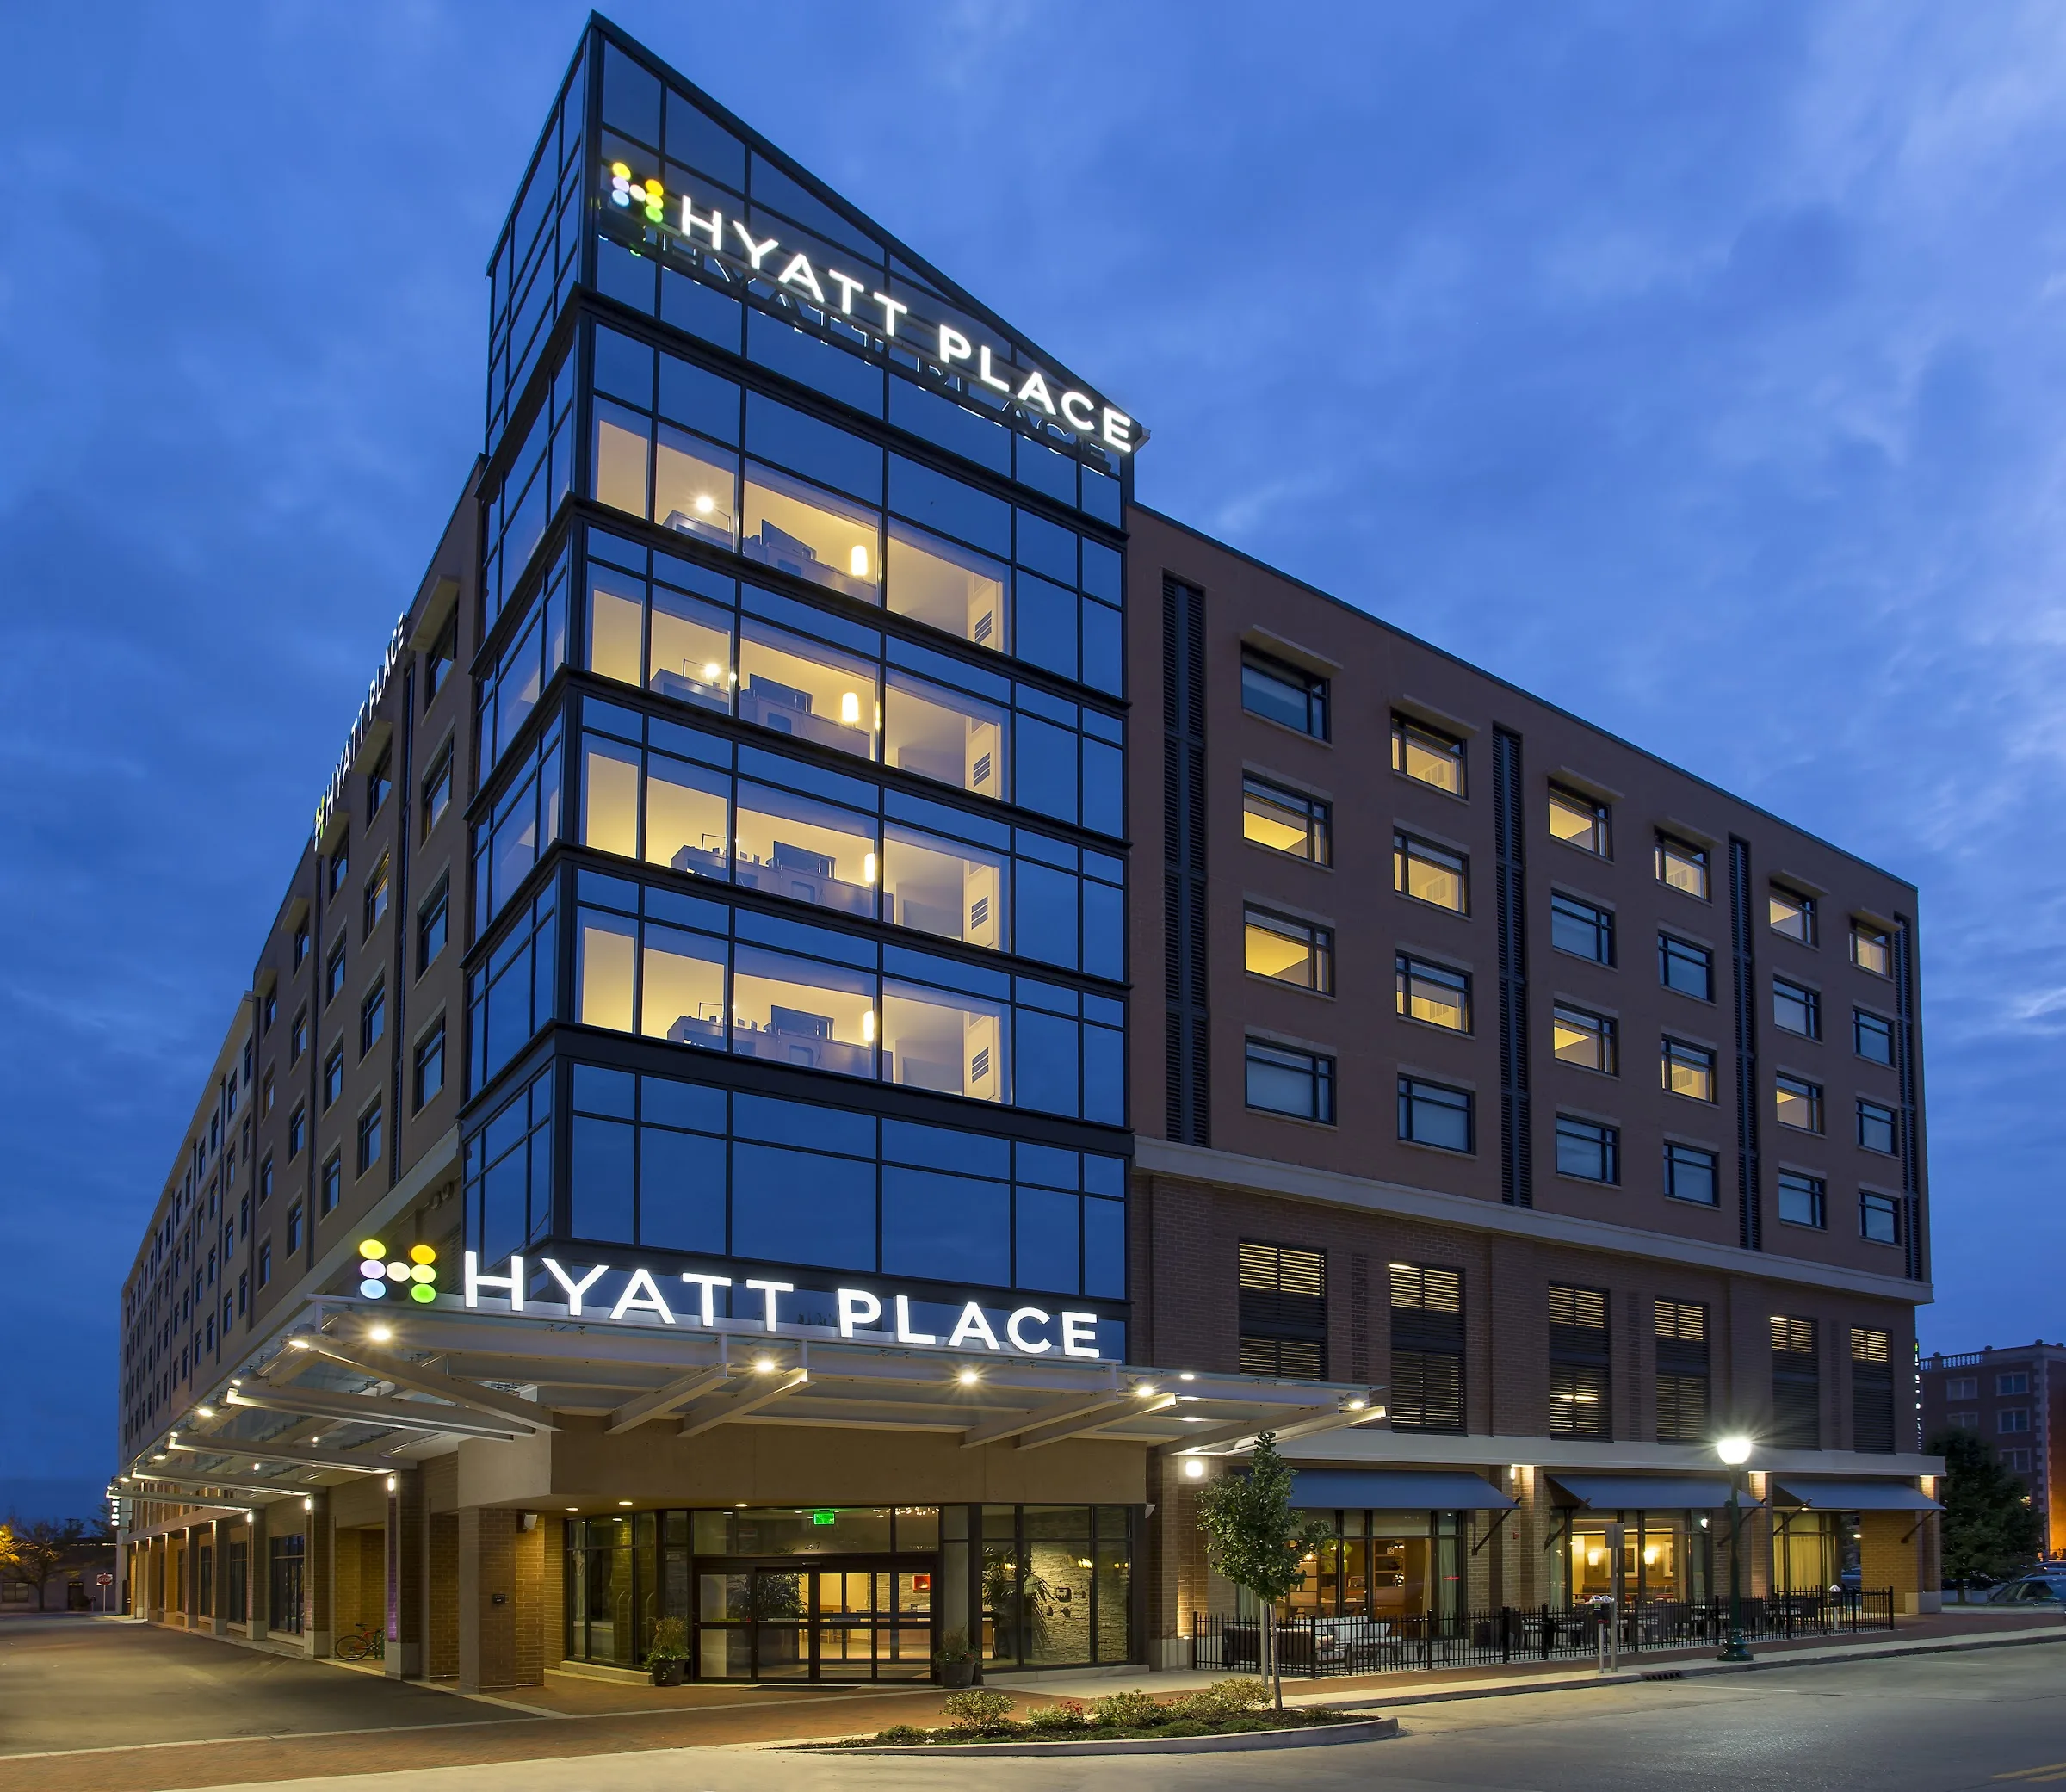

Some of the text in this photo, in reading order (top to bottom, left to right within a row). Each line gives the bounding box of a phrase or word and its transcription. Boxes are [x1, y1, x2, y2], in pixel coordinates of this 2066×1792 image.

[680, 194, 1133, 454] HYATT PLACE
[325, 611, 404, 827] HYATT PLACE
[464, 1250, 1101, 1359] HYATT PLACE
